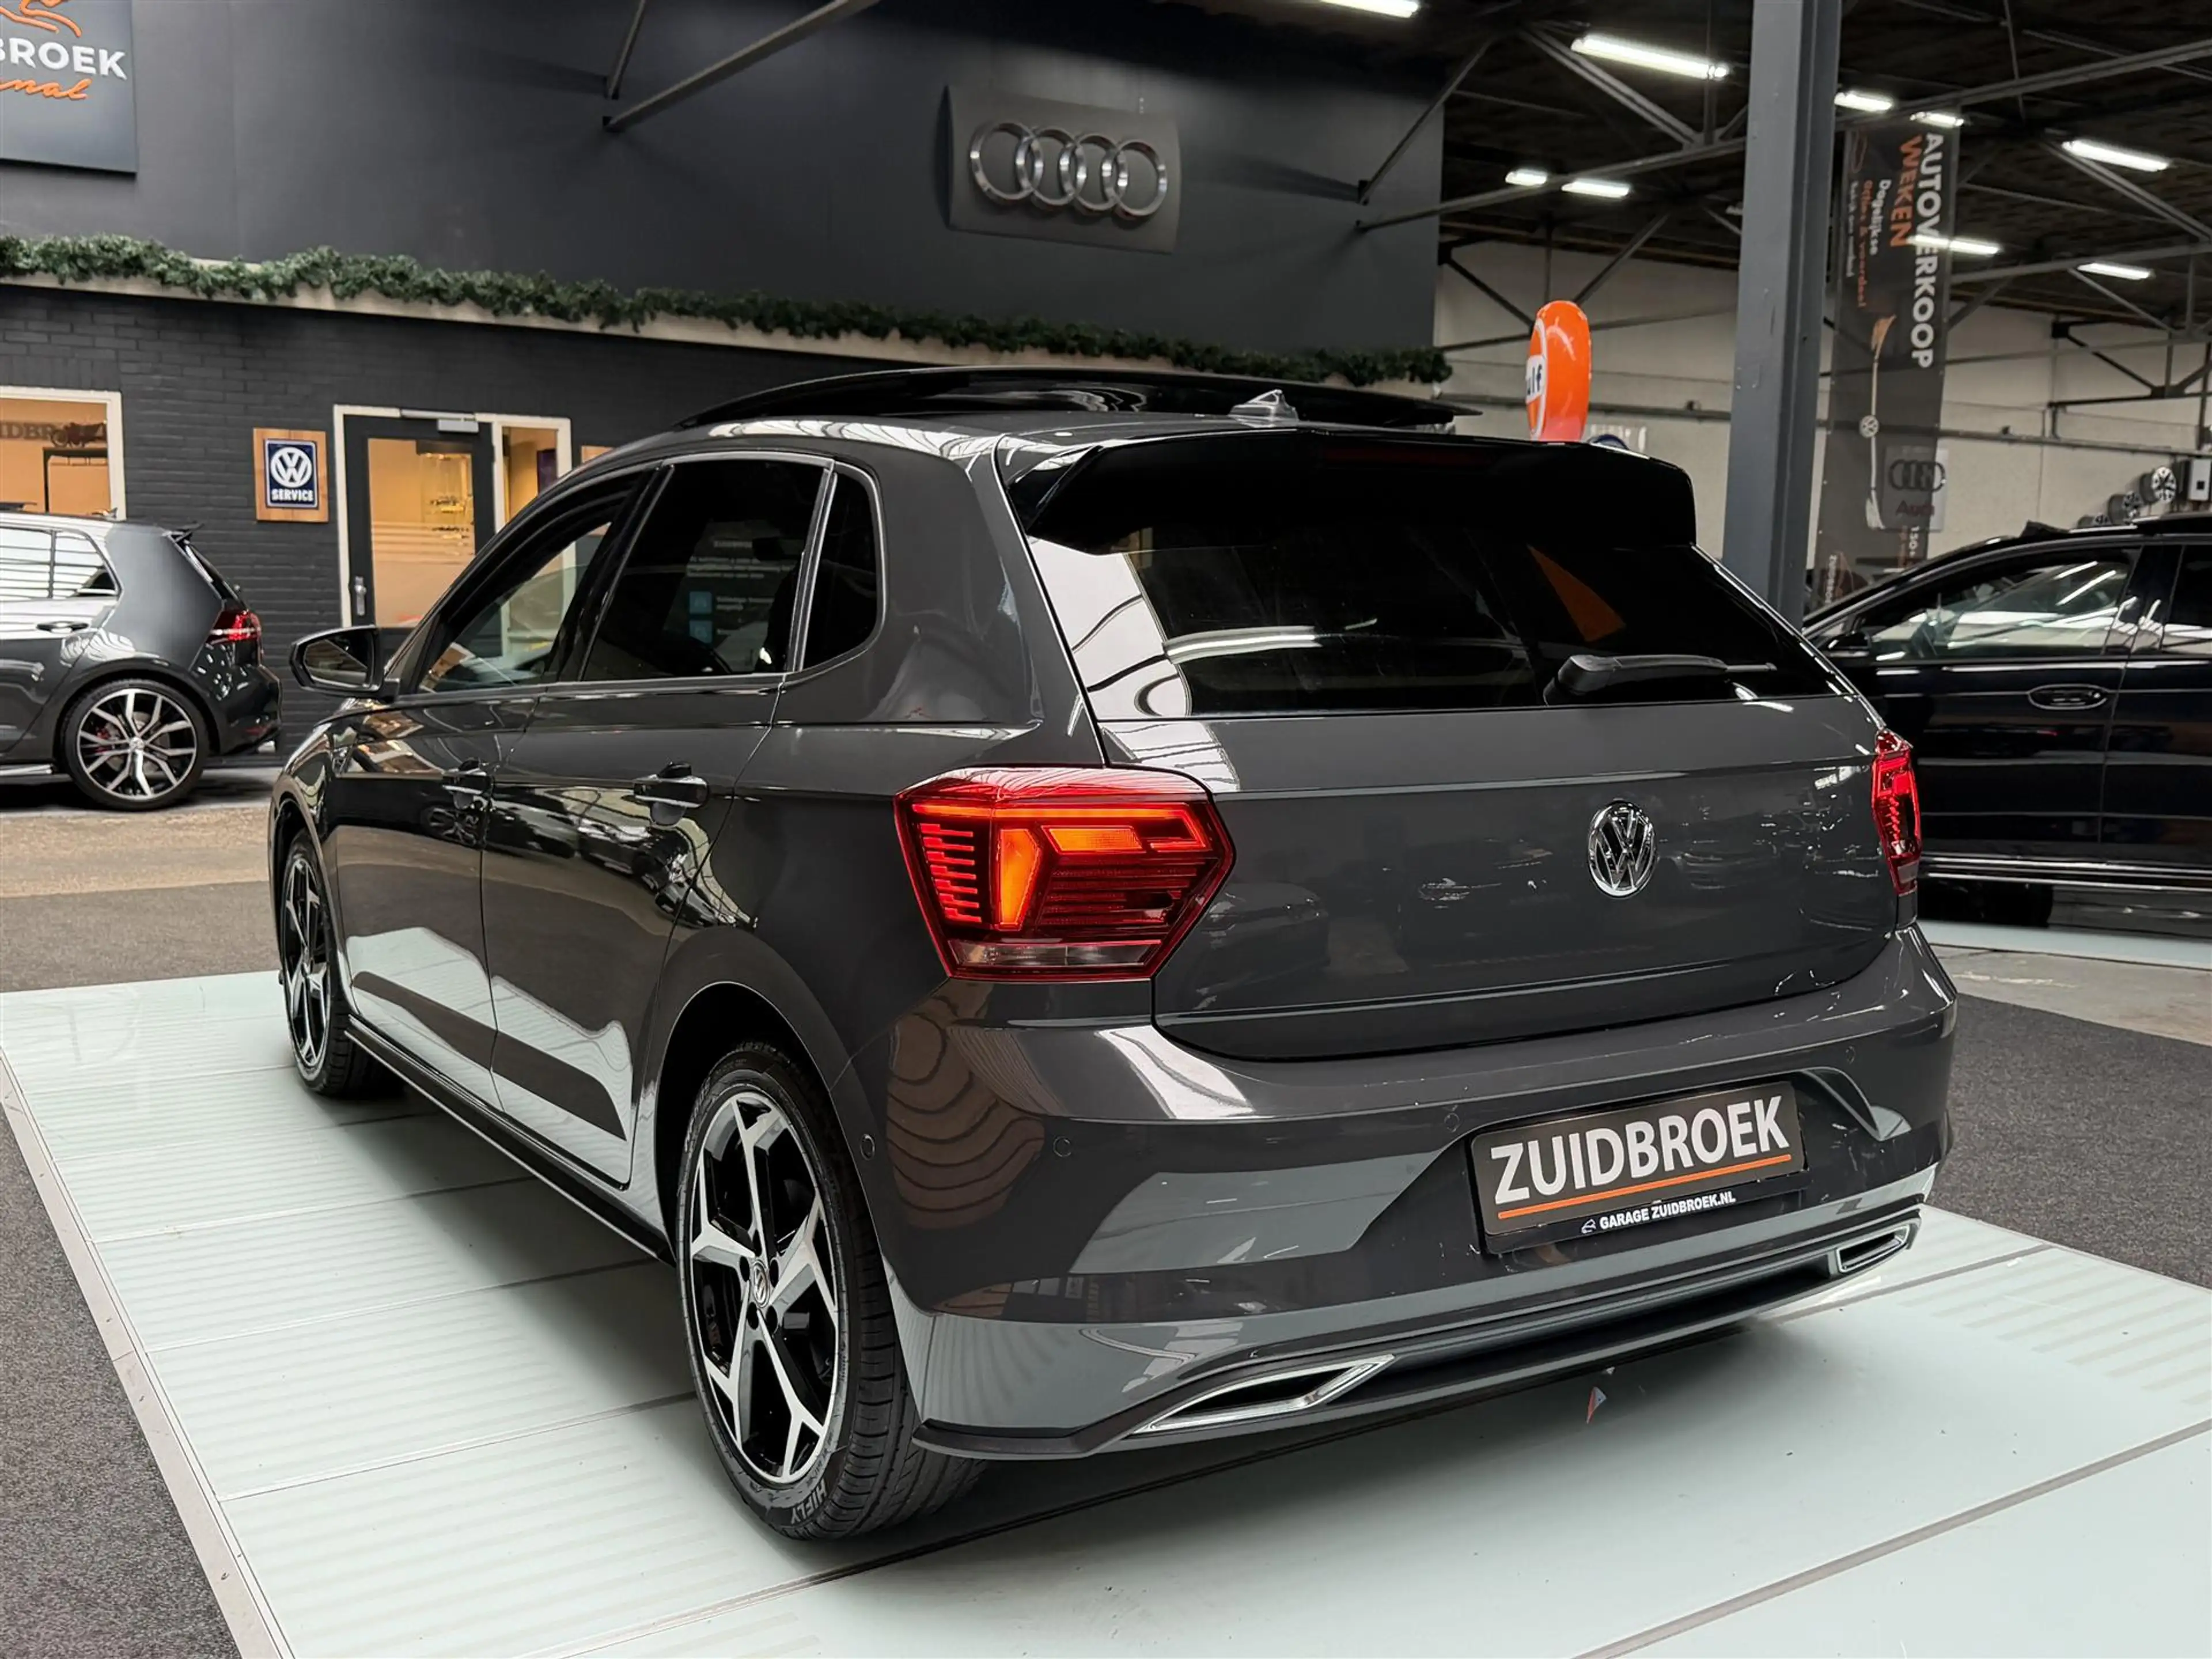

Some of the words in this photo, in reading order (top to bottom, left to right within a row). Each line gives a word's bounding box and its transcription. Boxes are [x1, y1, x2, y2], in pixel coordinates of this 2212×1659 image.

[0, 37, 127, 81] ROEK
[1890, 134, 1922, 247] WEKEN
[1910, 132, 1944, 369] AUTOVERKOOP
[271, 488, 314, 502] SERVICE
[1490, 1095, 1790, 1205] ZUIDBROEK
[1599, 1208, 1650, 1230] GARAGE
[1651, 1191, 1736, 1219] ZUIDBROEK.NL
